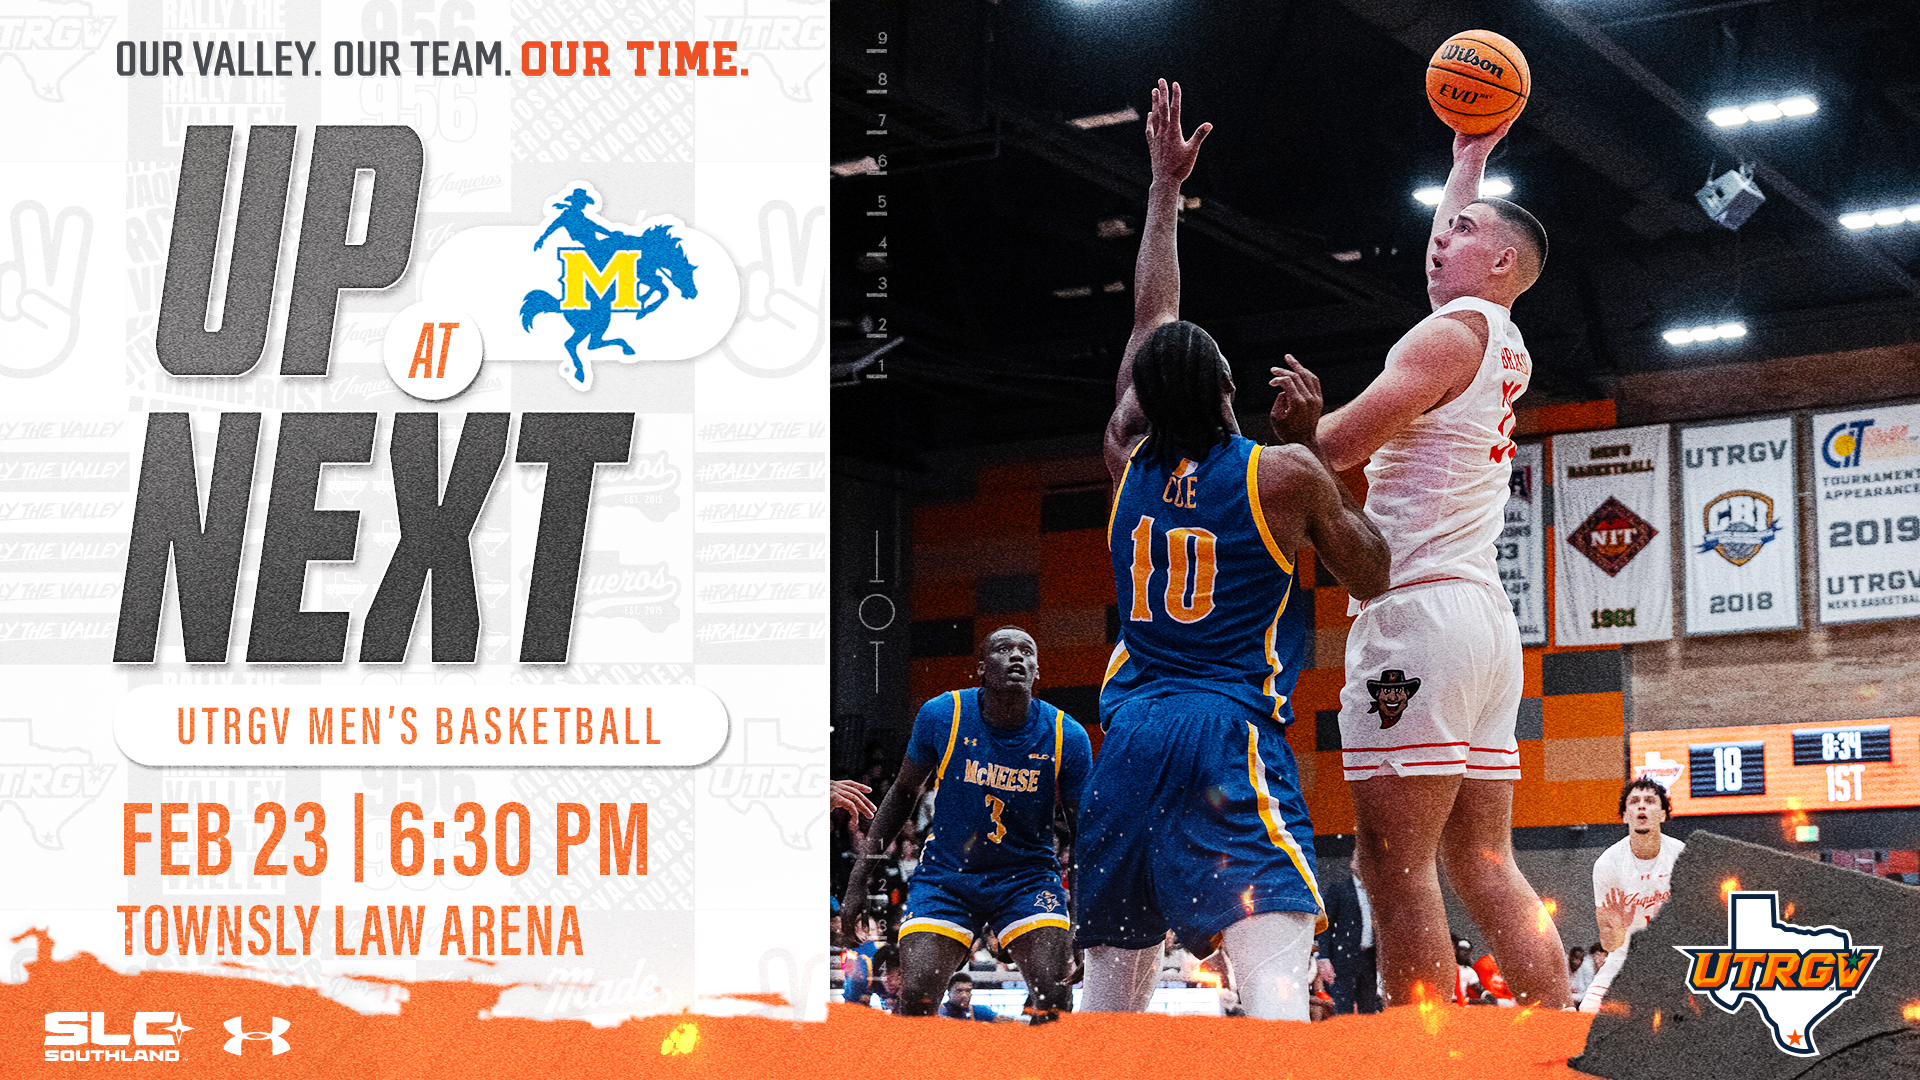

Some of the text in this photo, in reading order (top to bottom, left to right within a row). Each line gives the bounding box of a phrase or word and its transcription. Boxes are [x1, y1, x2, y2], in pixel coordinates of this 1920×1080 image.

[1441, 45, 1504, 79] Wilson
[1440, 84, 1479, 104] EVO
[1685, 440, 1788, 469] UTRGV
[1590, 527, 1638, 547] NIT
[1829, 515, 1920, 548] 2019
[1130, 515, 1220, 625] 10
[1710, 591, 1774, 614] 2018
[1821, 731, 1863, 761] 8:34
[963, 758, 1041, 793] McNEESE
[1712, 746, 1744, 792] 18
[1825, 763, 1867, 803] 1ST
[984, 793, 1008, 845] 3
